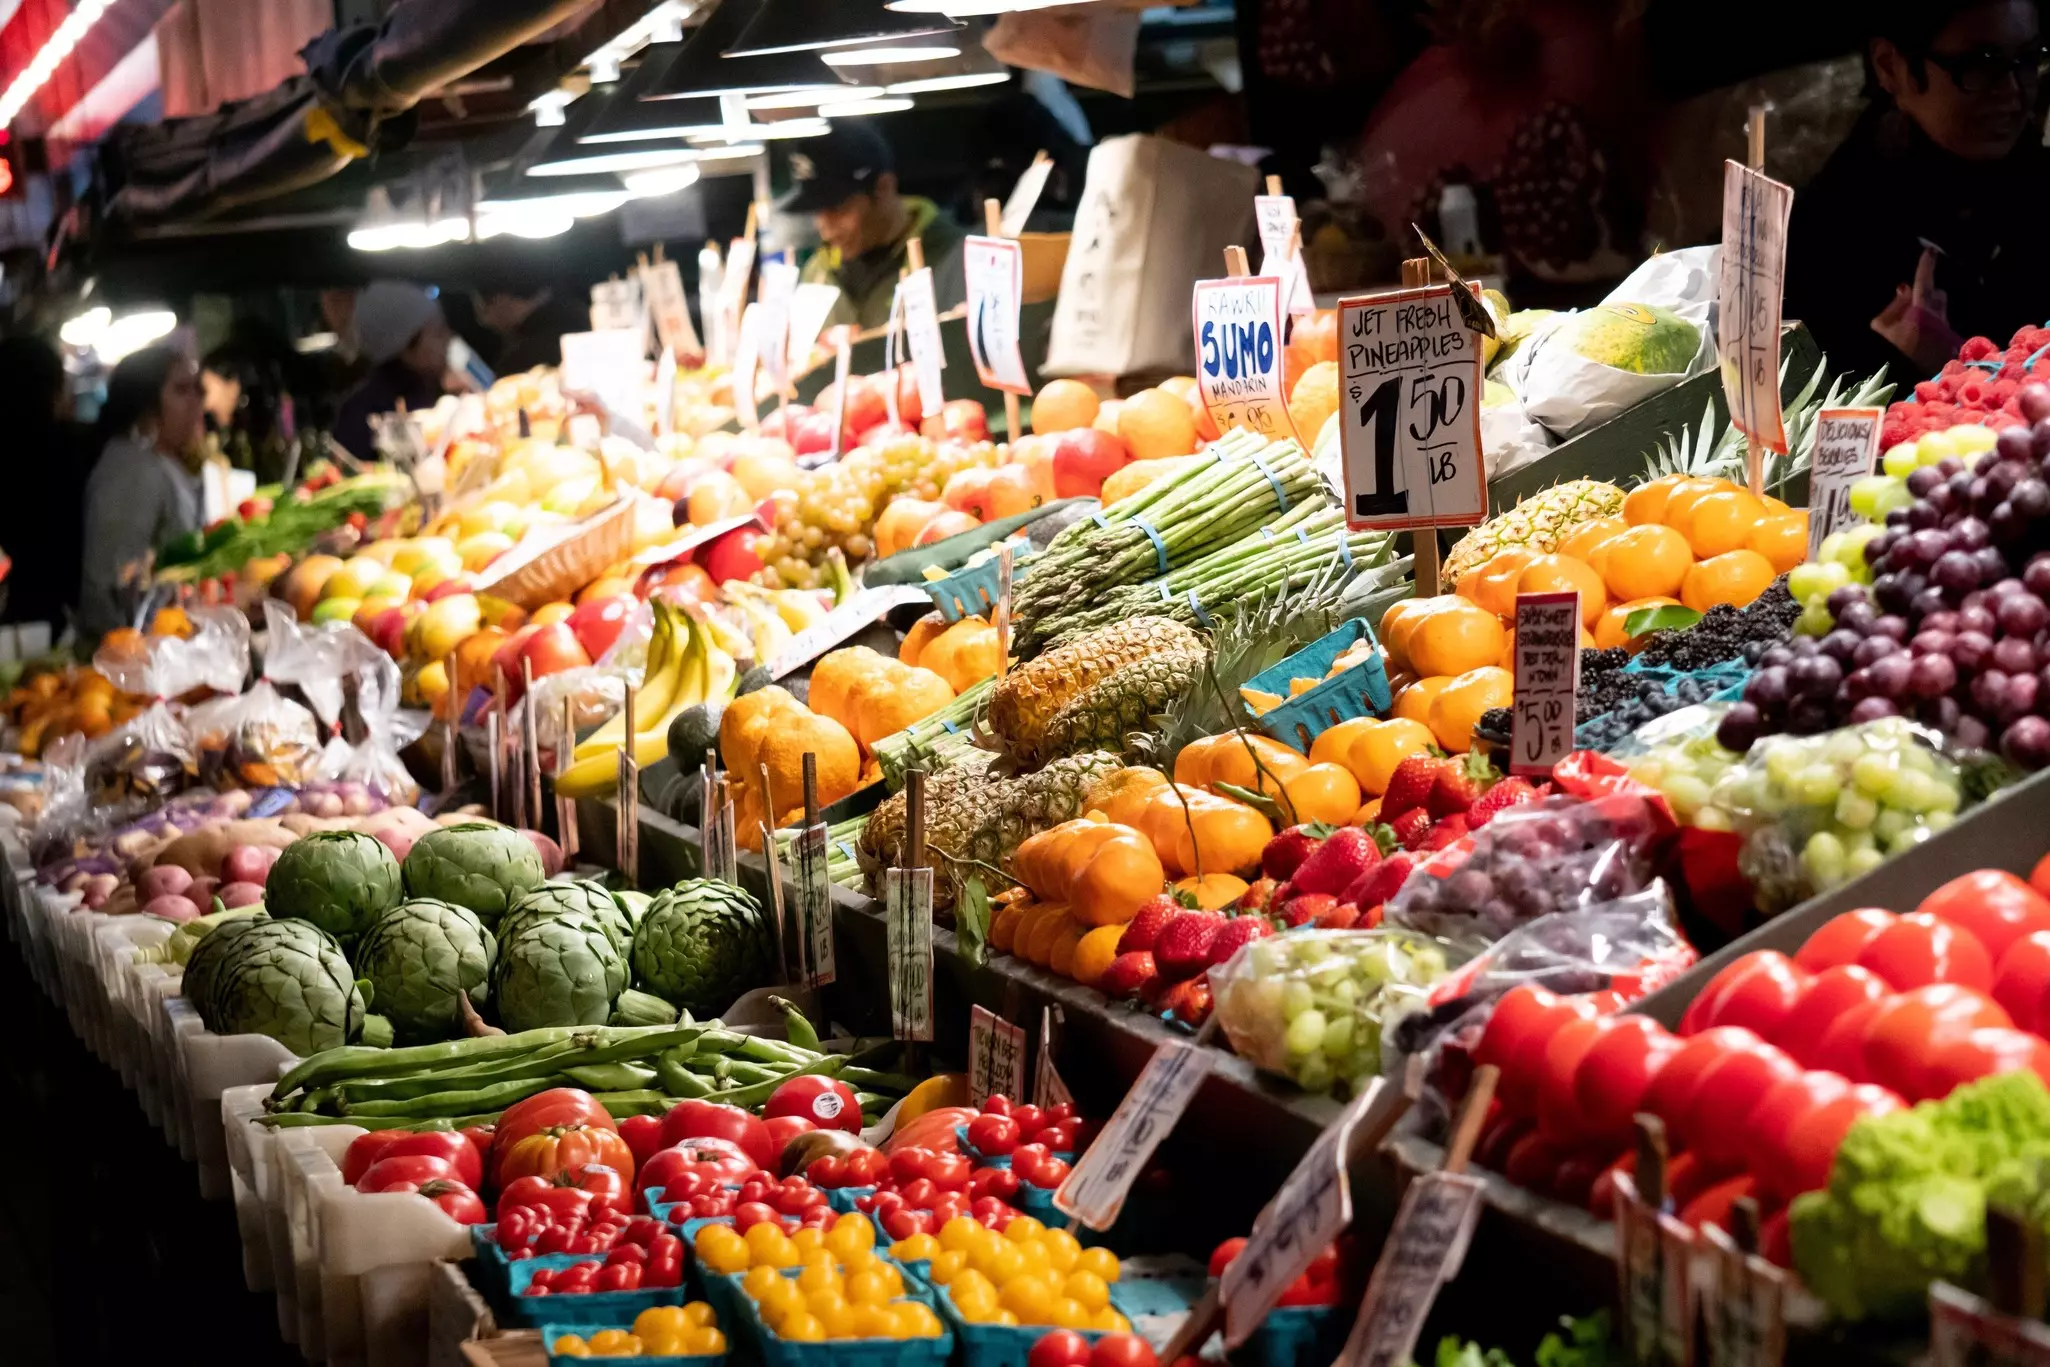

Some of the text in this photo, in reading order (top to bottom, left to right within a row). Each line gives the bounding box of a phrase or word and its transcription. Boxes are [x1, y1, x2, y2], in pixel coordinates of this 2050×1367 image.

[1352, 297, 1452, 338] JET FRESH
[1202, 320, 1274, 380] SUMO
[1348, 331, 1465, 369] PINEAPPLES
[1212, 376, 1268, 402] MANDARIN
[1429, 450, 1457, 486] LB
